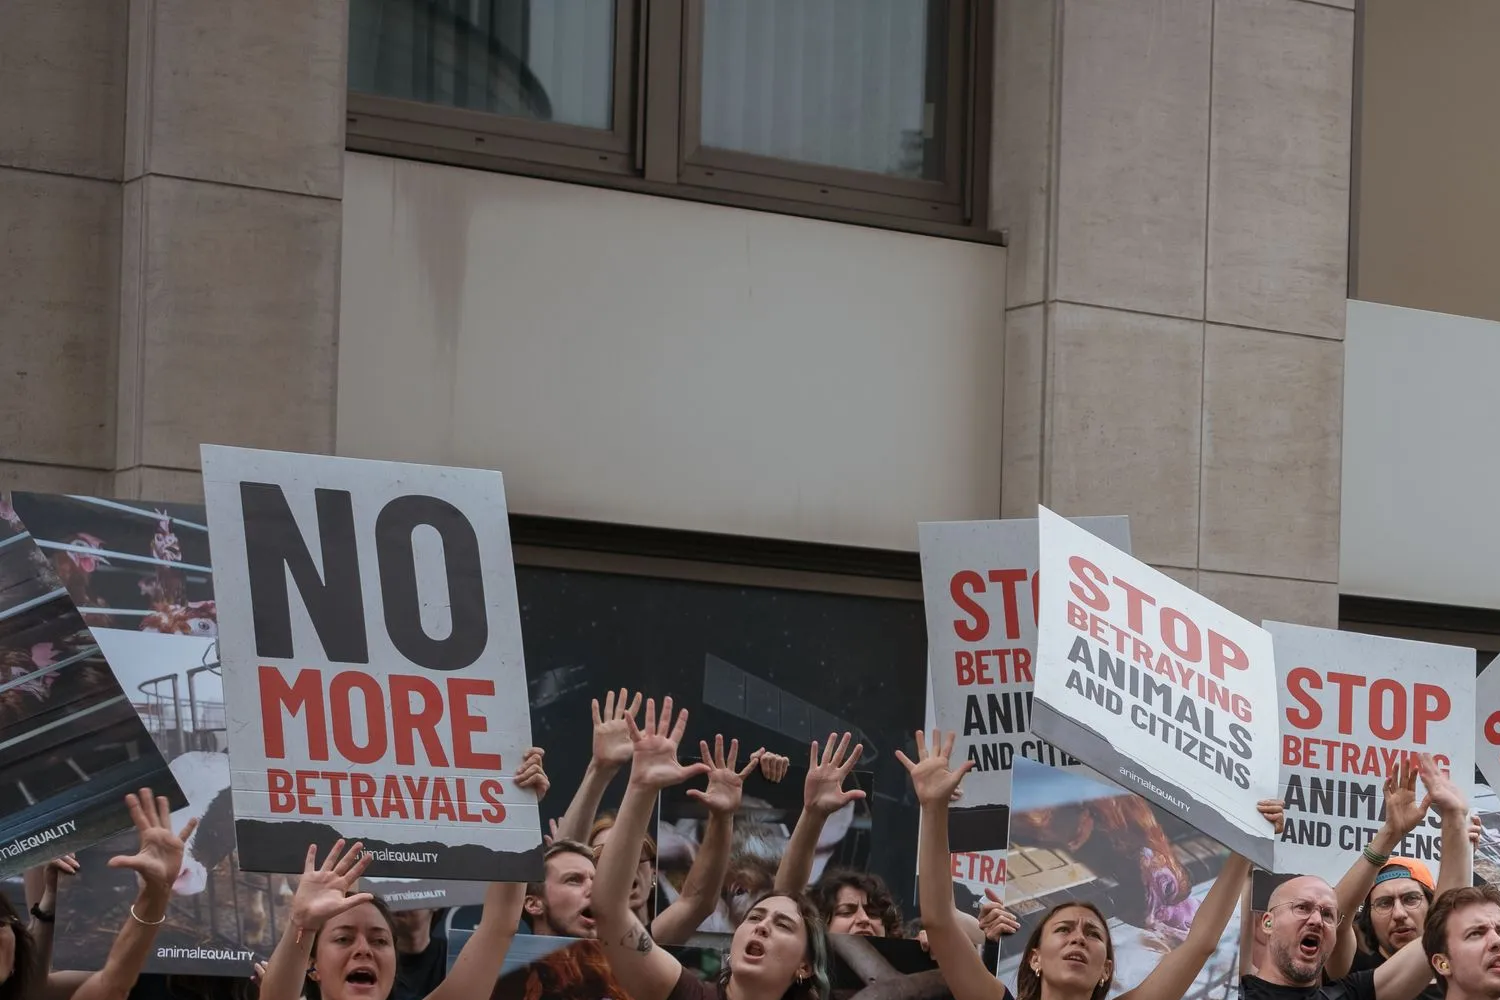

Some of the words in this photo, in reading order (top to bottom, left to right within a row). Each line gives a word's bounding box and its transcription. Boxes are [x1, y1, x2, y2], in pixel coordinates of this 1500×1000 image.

[240, 481, 489, 671] NO
[949, 568, 1040, 642] ST
[1068, 555, 1250, 680] STOP
[1067, 600, 1252, 723] BETRAYING
[258, 666, 502, 771] MORE
[1065, 670, 1123, 717] AND
[1130, 703, 1251, 790] CITIZENS
[1067, 635, 1253, 761] ANIMALS
[1285, 667, 1452, 745] STOP
[967, 742, 1014, 772] AND
[1119, 766, 1191, 812] animalEQUALITY
[267, 768, 507, 824] BETRAYALS
[1284, 773, 1442, 830] ANIMS
[0, 820, 76, 860] malEQUALITY
[354, 846, 438, 864] nimalEQUALITY
[1281, 817, 1332, 847] AND
[1338, 824, 1442, 862] CITENS
[157, 945, 255, 961] animalEQUALITY
